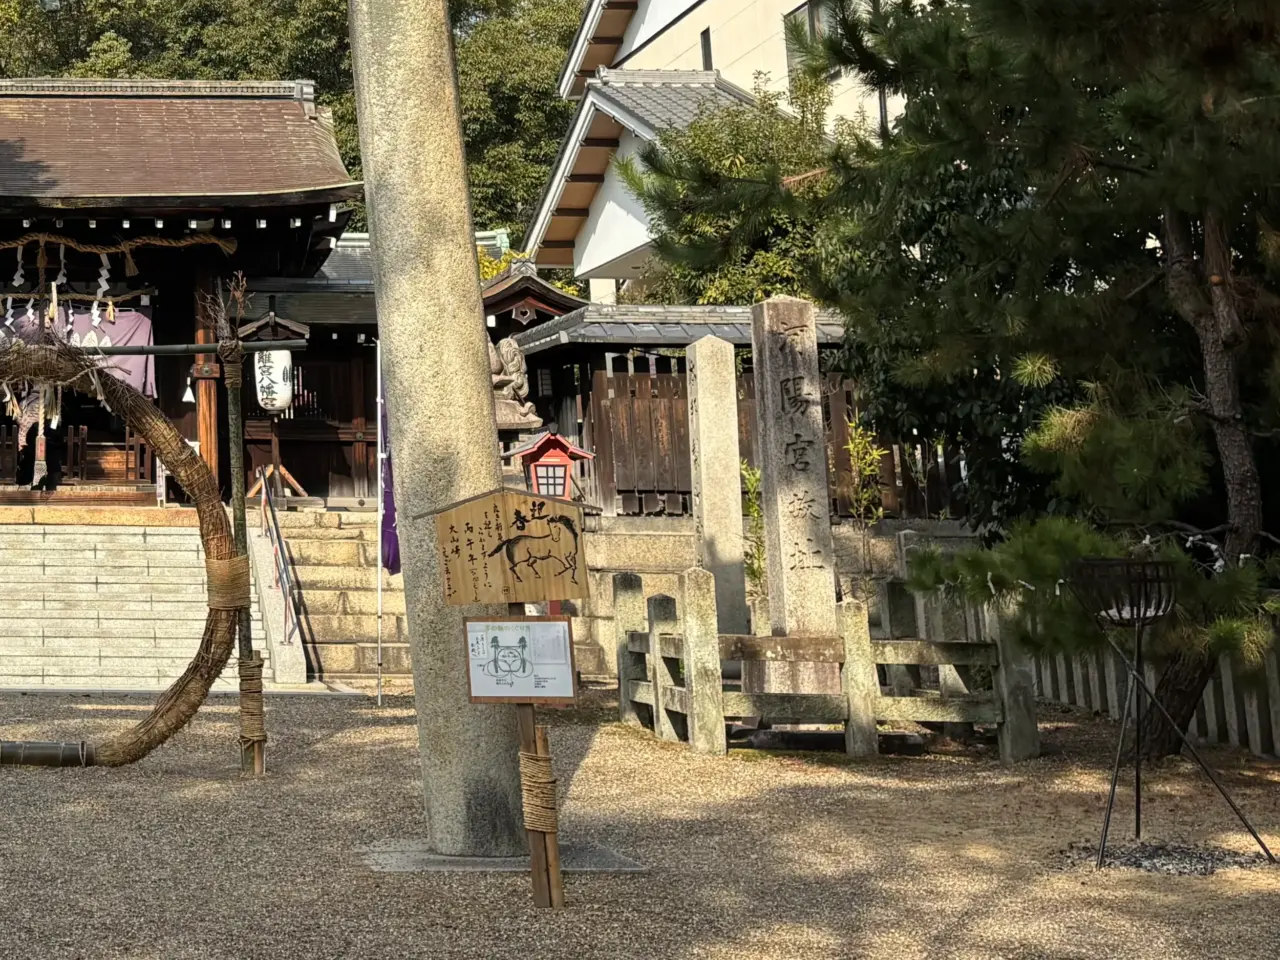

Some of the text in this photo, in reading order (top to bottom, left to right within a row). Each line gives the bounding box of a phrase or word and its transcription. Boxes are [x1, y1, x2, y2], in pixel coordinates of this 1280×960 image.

[510, 500, 550, 531] 迎春
[777, 321, 825, 571] 河陽宮故址
